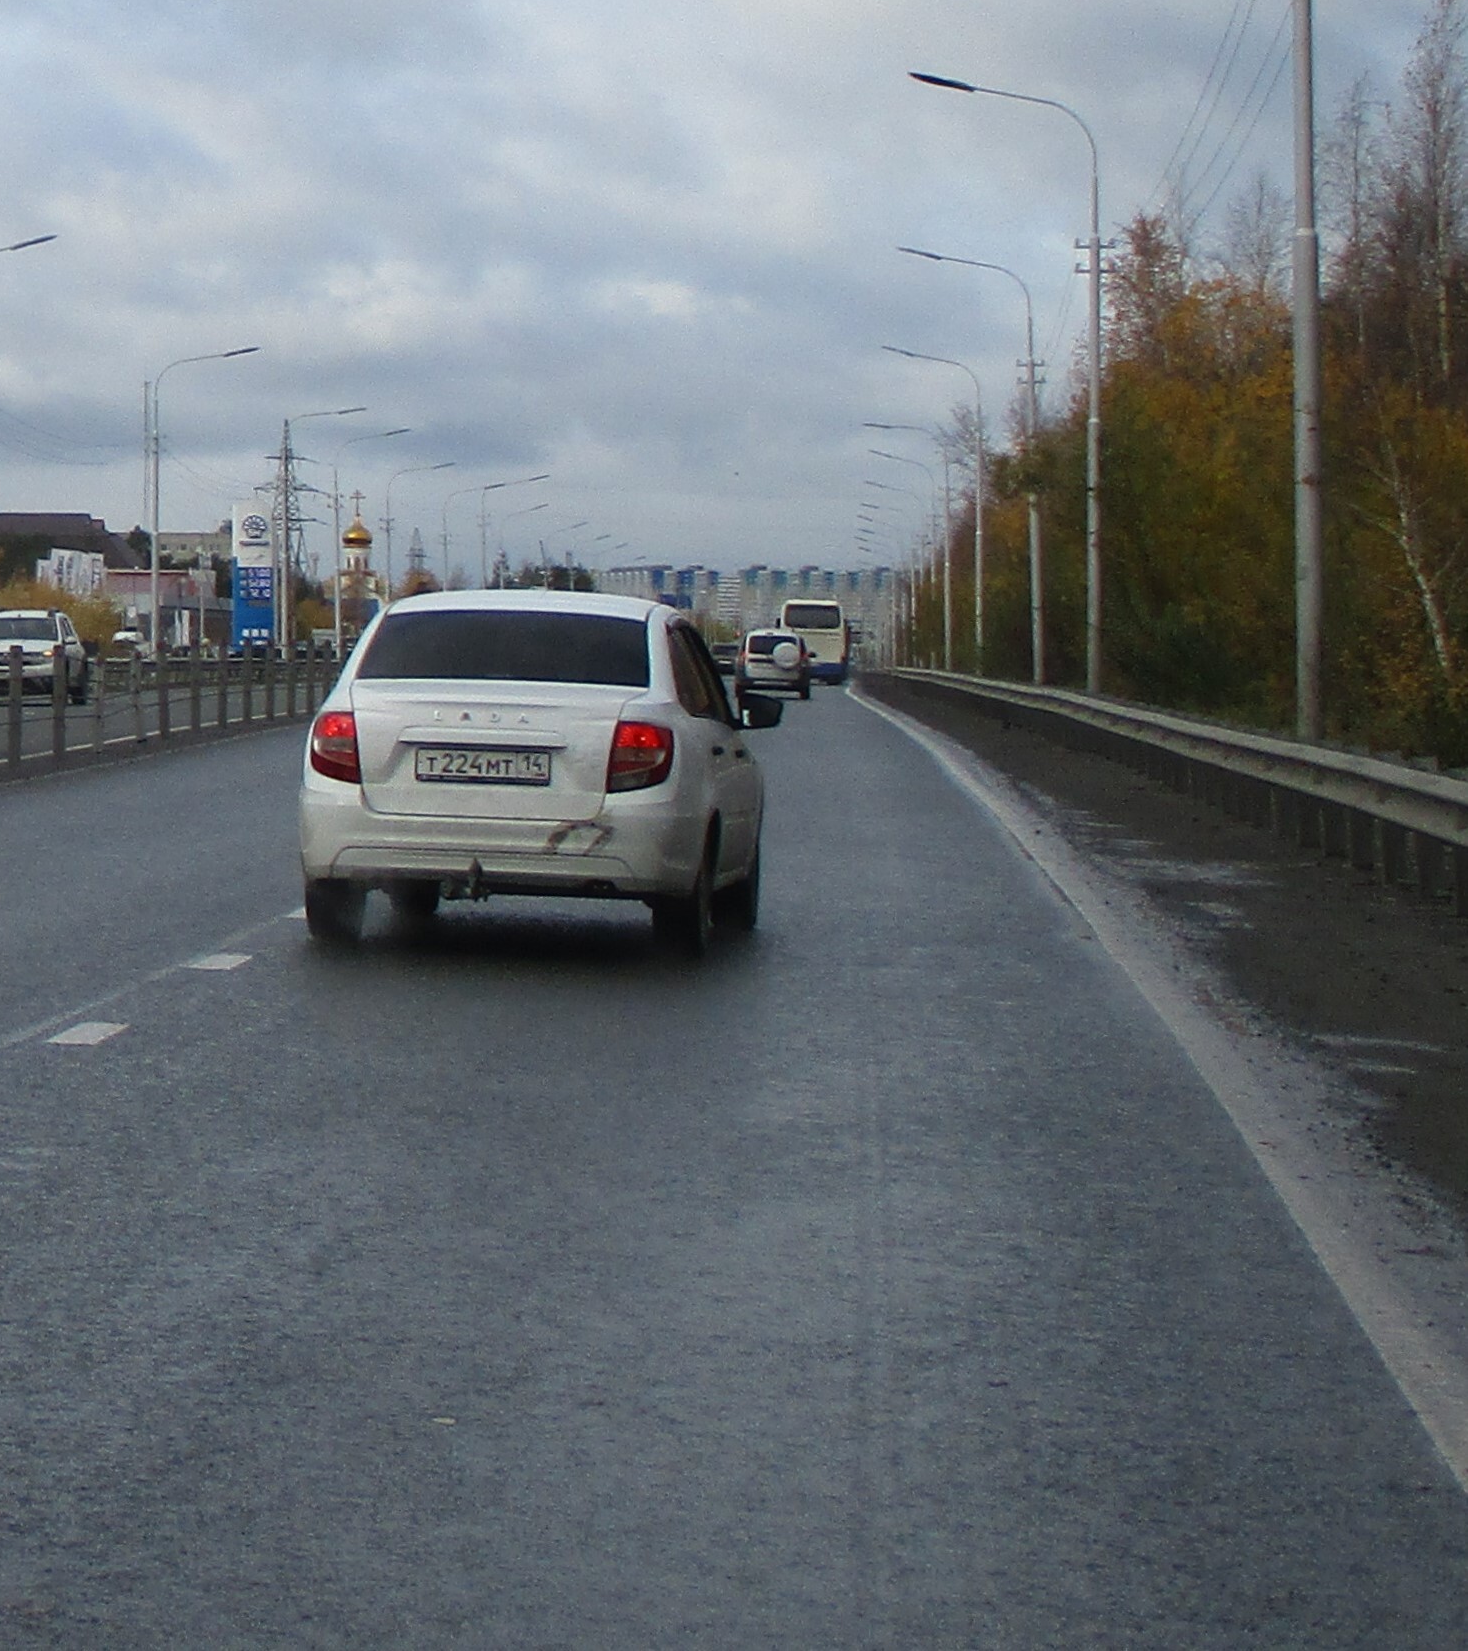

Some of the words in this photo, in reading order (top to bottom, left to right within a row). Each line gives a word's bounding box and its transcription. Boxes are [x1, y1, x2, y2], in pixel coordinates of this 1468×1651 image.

[433, 709, 529, 724] LADA
[425, 753, 513, 775] Т224МТ
[523, 754, 542, 771] 14
